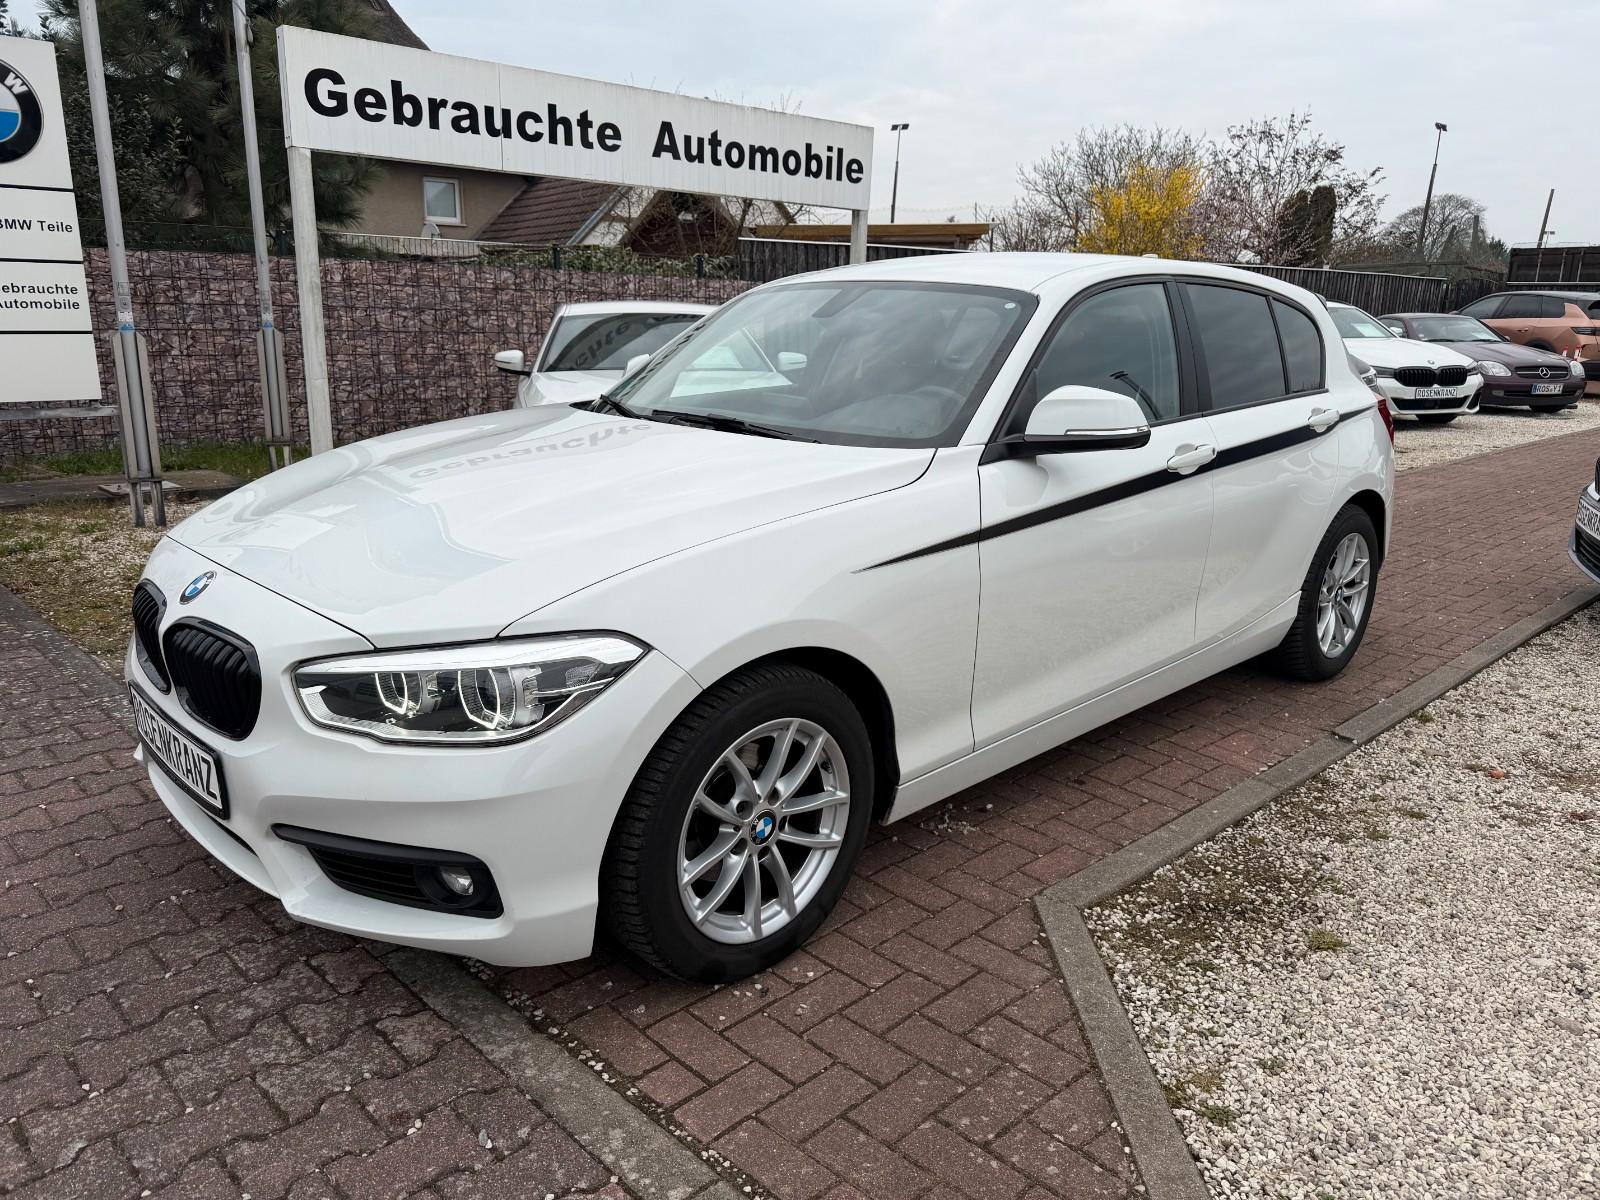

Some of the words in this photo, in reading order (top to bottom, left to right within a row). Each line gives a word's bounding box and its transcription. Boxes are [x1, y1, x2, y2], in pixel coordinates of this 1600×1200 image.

[304, 67, 622, 153] Gebrauchte
[651, 120, 864, 184] Automobile
[37, 220, 73, 233] Teile
[0, 282, 79, 295] ebrauchte
[132, 694, 218, 801] ROSENKRANZ
